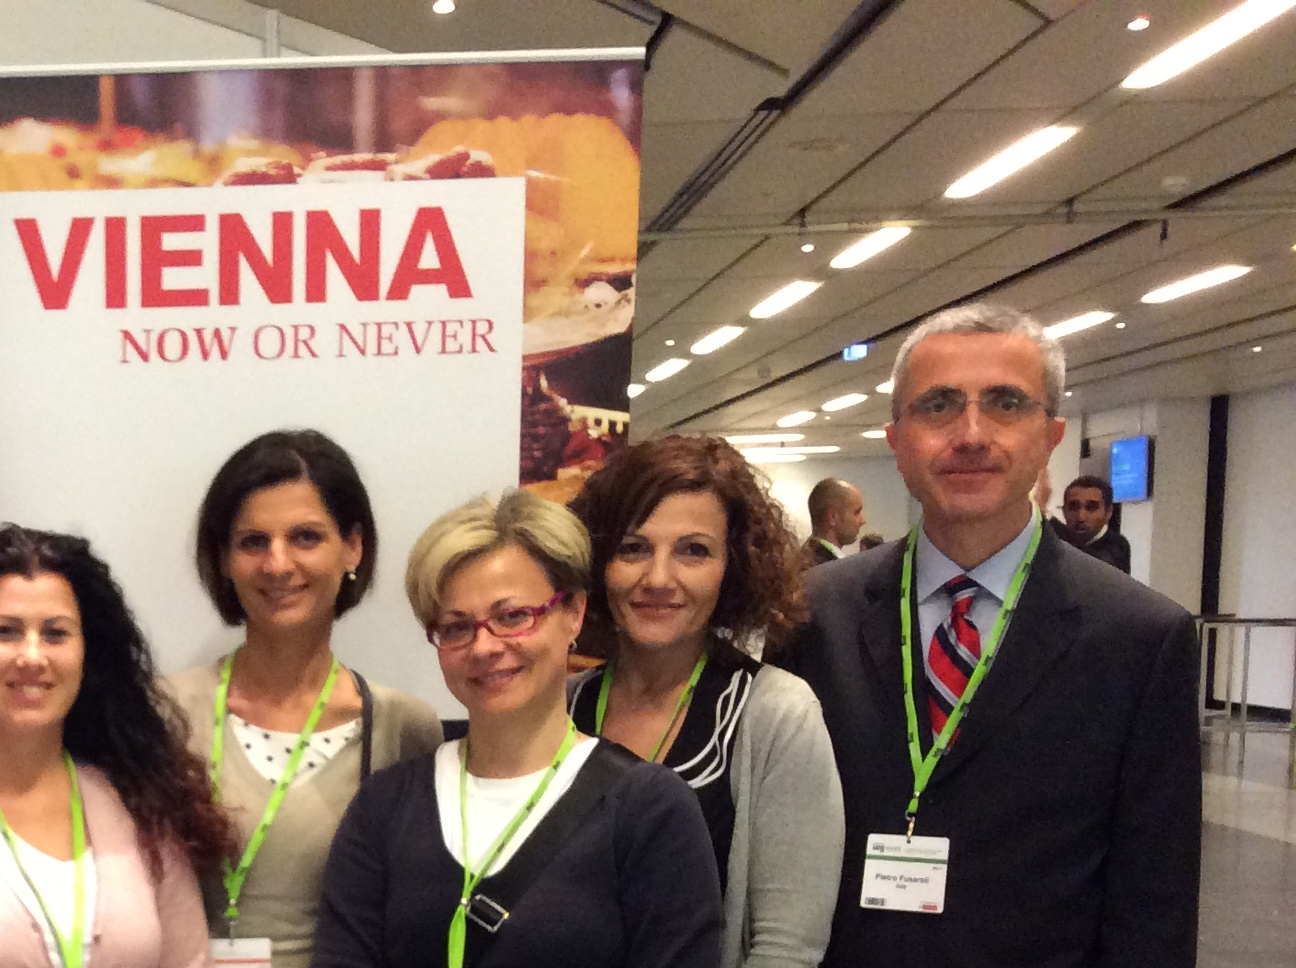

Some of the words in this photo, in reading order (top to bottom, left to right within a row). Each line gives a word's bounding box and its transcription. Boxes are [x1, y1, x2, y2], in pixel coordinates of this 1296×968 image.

[13, 205, 474, 312] VIENNA
[120, 327, 238, 364] NOW
[252, 322, 319, 360] OR
[335, 318, 498, 358] NEVER
